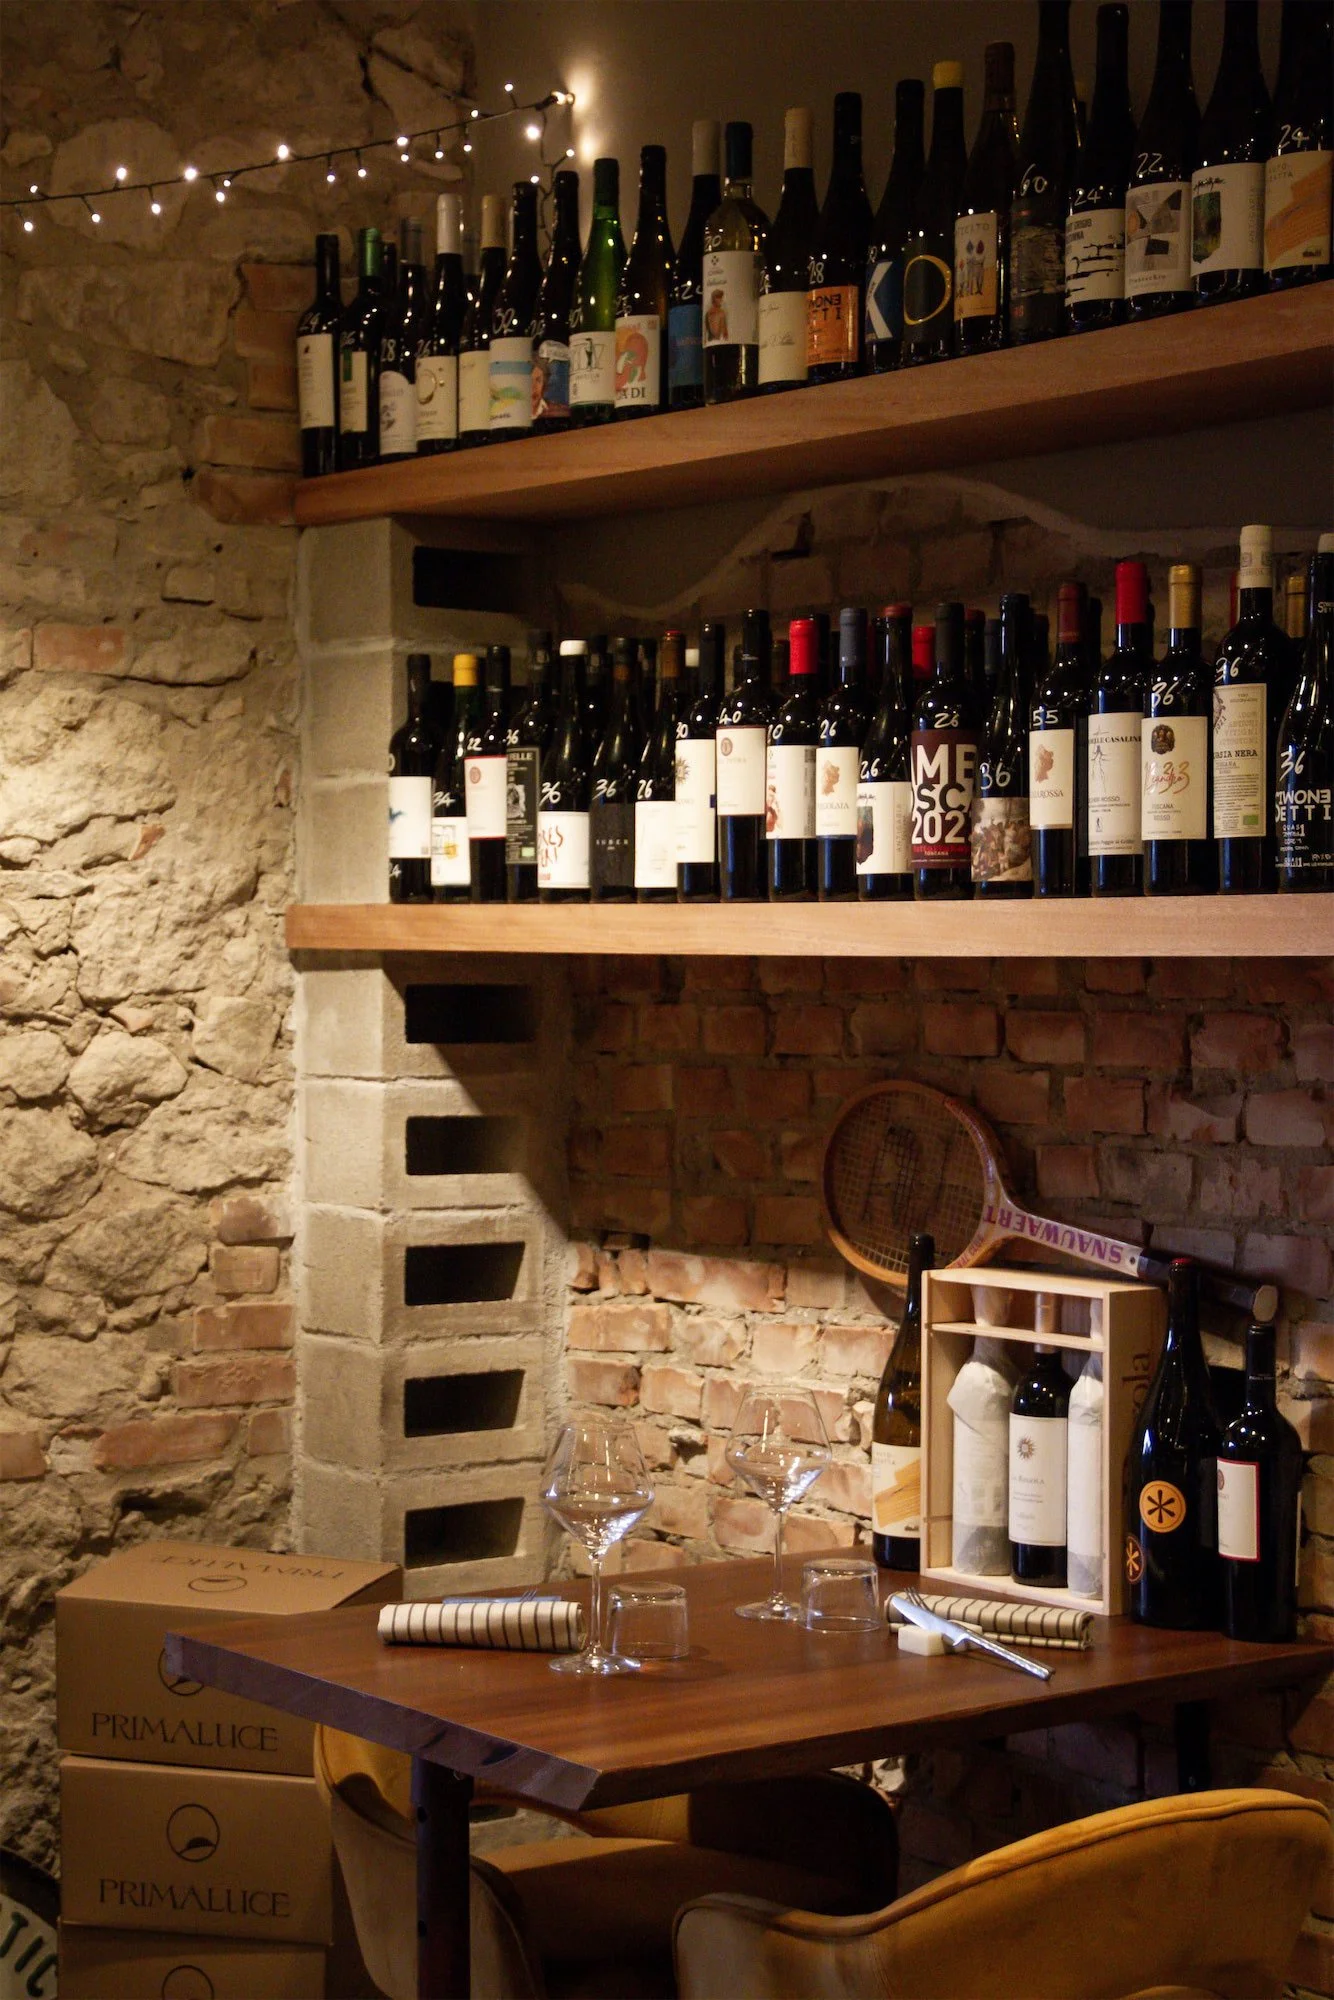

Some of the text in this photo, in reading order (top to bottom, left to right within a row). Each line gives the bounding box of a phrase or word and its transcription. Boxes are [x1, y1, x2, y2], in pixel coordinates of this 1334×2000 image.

[1279, 124, 1309, 150] 24
[1136, 152, 1163, 177] 22
[1020, 163, 1048, 197] 60
[1074, 187, 1103, 207] 24
[1151, 681, 1181, 708] 36
[820, 720, 837, 740] 26
[1032, 709, 1059, 726] 55
[467, 737, 483, 751] 22
[860, 758, 880, 780] 26
[1280, 750, 1305, 783] 36
[593, 779, 618, 800] 36
[637, 779, 653, 800] 26
[983, 1205, 1124, 1264] SNAUWAERT
[91, 1712, 280, 1753] PRIMALUCE
[98, 1878, 292, 1919] PRIMALUCE
